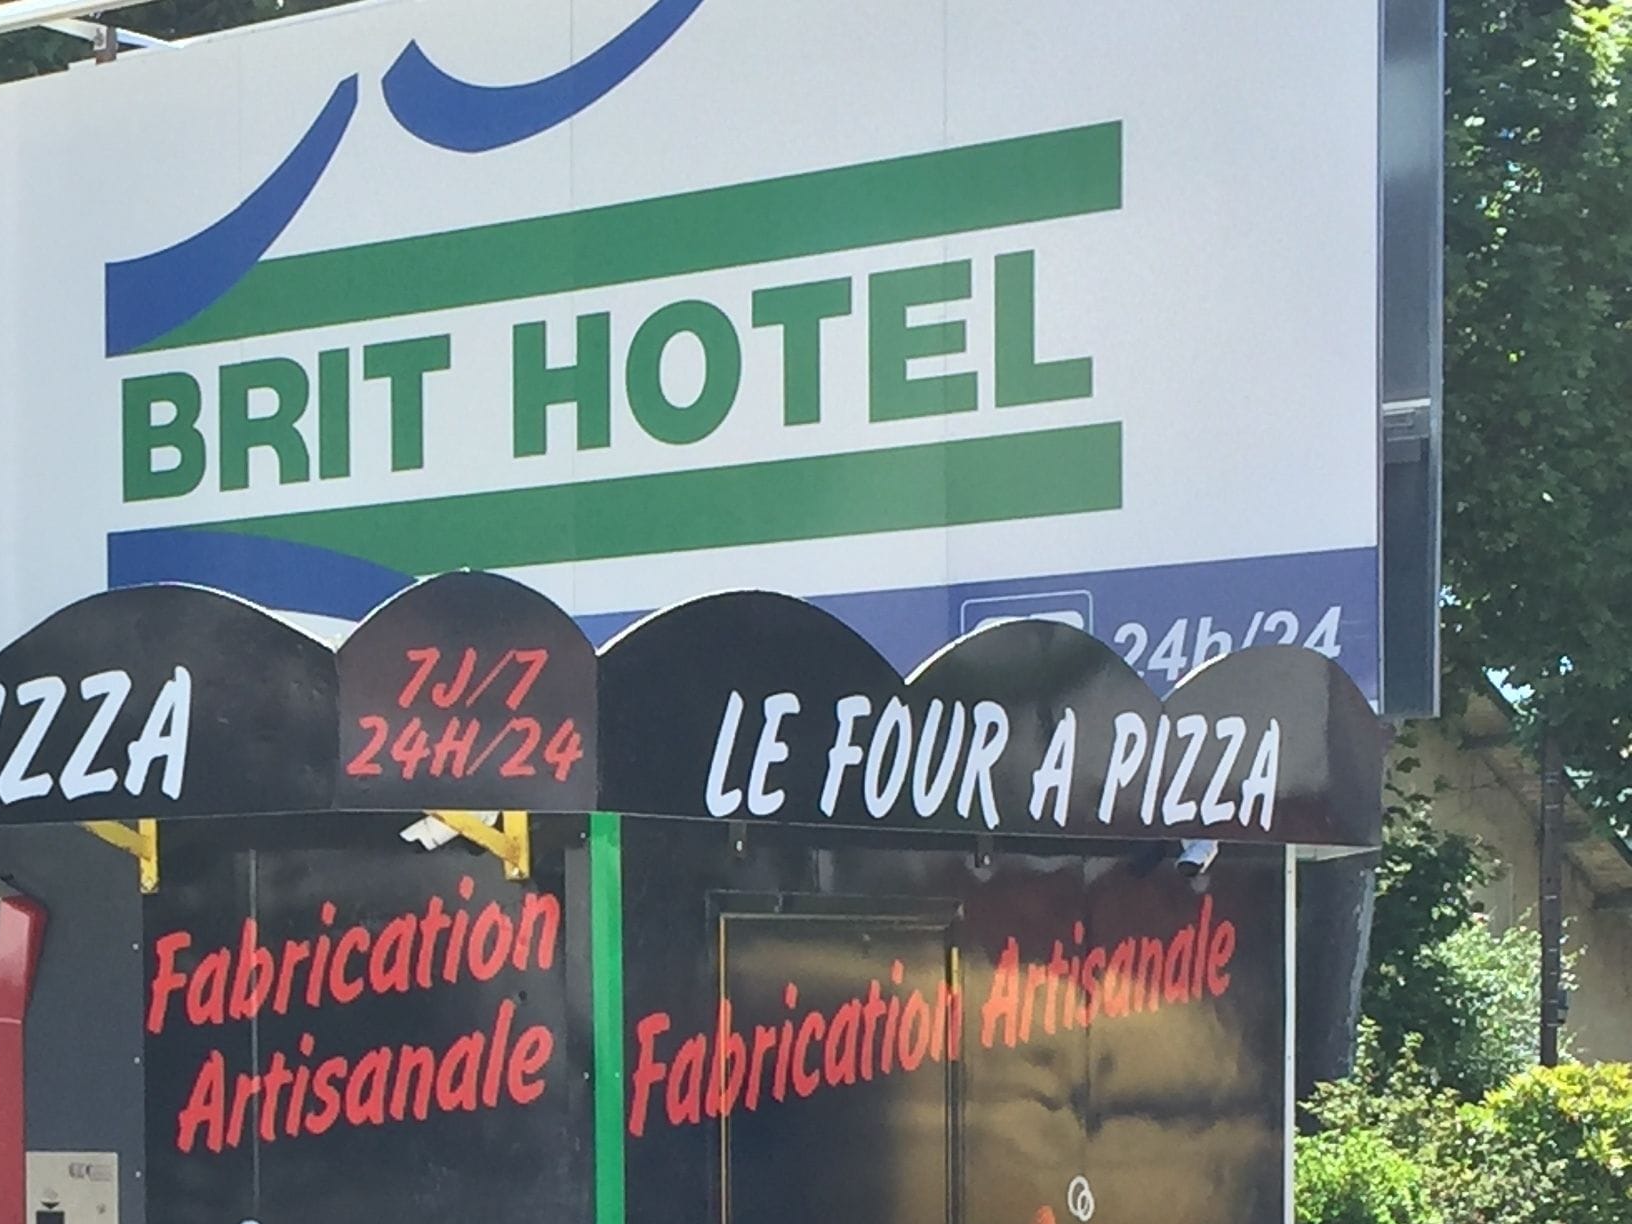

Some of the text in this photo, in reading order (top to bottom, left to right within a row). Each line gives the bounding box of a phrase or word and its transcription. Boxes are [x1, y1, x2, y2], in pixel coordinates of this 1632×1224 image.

[122, 249, 1093, 503] BRIT HOTEL
[346, 716, 583, 782] 24H/24
[398, 647, 549, 709] 7J/7
[705, 690, 1281, 831] LE FOUR A PIZZA
[146, 875, 561, 1034] Fabrication
[628, 895, 1236, 1137] Fabrication Artisanale
[177, 998, 556, 1154] Artisanale
